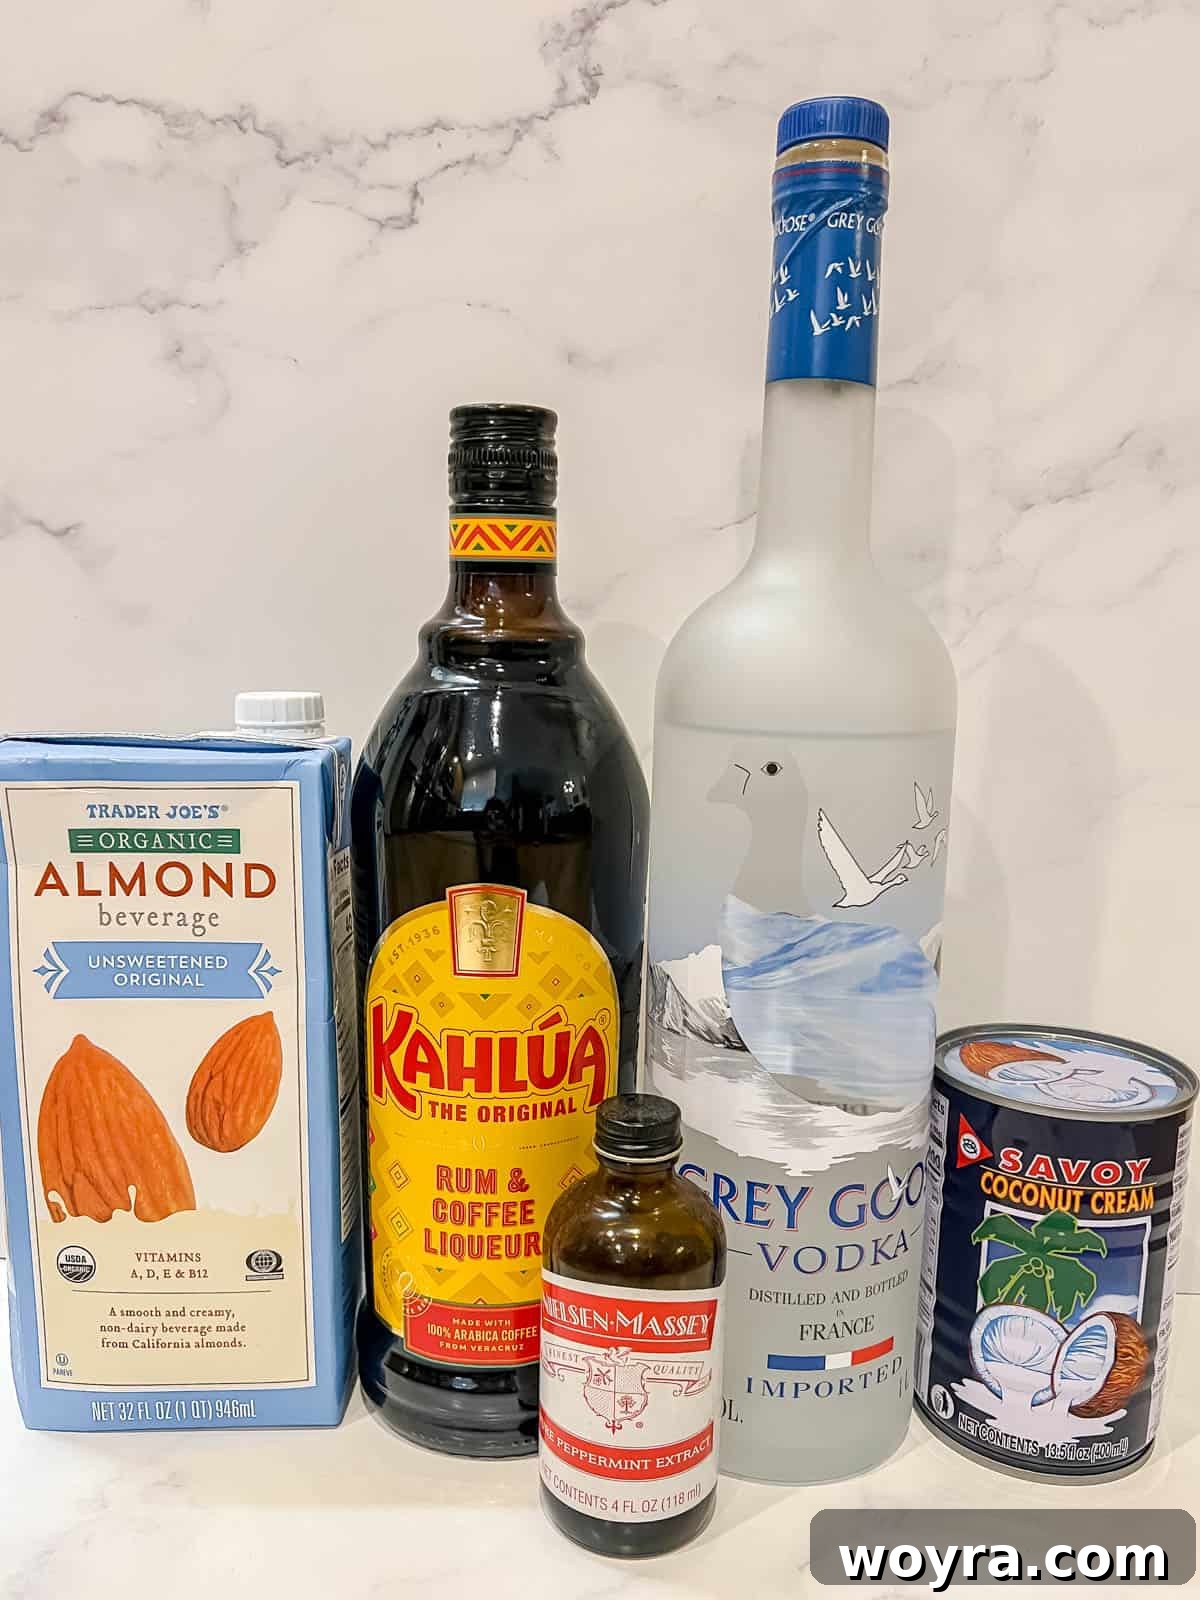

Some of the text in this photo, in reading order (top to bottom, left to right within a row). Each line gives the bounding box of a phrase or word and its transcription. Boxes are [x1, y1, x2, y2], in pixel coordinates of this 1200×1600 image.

[827, 212, 864, 231] GREY
[86, 804, 222, 820] TRADER JOE'S
[98, 831, 214, 850] ORGANIC
[34, 860, 277, 899] ALMOND
[98, 902, 220, 937] beverage
[88, 955, 228, 970] UNSWEETENED
[113, 972, 206, 988] ORIGINAL
[371, 1003, 607, 1114] KAHLÚA
[428, 1096, 577, 1123] THE ORIGINAL
[999, 1147, 1152, 1185] SAVOY
[435, 1164, 530, 1194] RUM &
[980, 1171, 1155, 1215] COCONUT CREAM
[431, 1198, 536, 1228] COFFEE
[423, 1228, 543, 1262] LIQUEUR
[756, 1229, 910, 1275] VODKA
[65, 1254, 87, 1264] USDA
[135, 1251, 201, 1264] VITAMINS
[130, 1268, 209, 1281] A, D, E & B12
[749, 1269, 909, 1306] DISTILLED AND BOTTLED
[109, 1307, 236, 1321] A smooth and creamy,
[452, 1317, 511, 1328] MADE WITH
[99, 1322, 247, 1337] non-dairy beverage made
[427, 1323, 538, 1342] 100% ARABICA COFFEE
[799, 1313, 875, 1341] FRANCE
[100, 1338, 247, 1350] from California almonds.
[439, 1341, 524, 1353] FROM VERACRUZ
[653, 1363, 700, 1376] QUALITY
[745, 1355, 903, 1400] IMPORTED
[91, 1401, 116, 1422] NET
[118, 1401, 135, 1422] 32
[138, 1401, 152, 1421] FL
[155, 1401, 173, 1421] OZ
[175, 1400, 187, 1422] (1
[190, 1400, 214, 1421] QT)
[957, 1413, 978, 1437] NET
[980, 1424, 1040, 1457] CONTENTS
[1045, 1442, 1067, 1460] 13.5
[1077, 1447, 1090, 1460] oz
[1090, 1441, 1112, 1463] (400
[556, 1437, 652, 1470] PEPPERMINT
[656, 1434, 712, 1469] EXTRACT
[553, 1475, 608, 1511] CONTENTS
[611, 1499, 619, 1512] 4
[641, 1499, 658, 1513] OZ
[661, 1492, 686, 1513] (118
